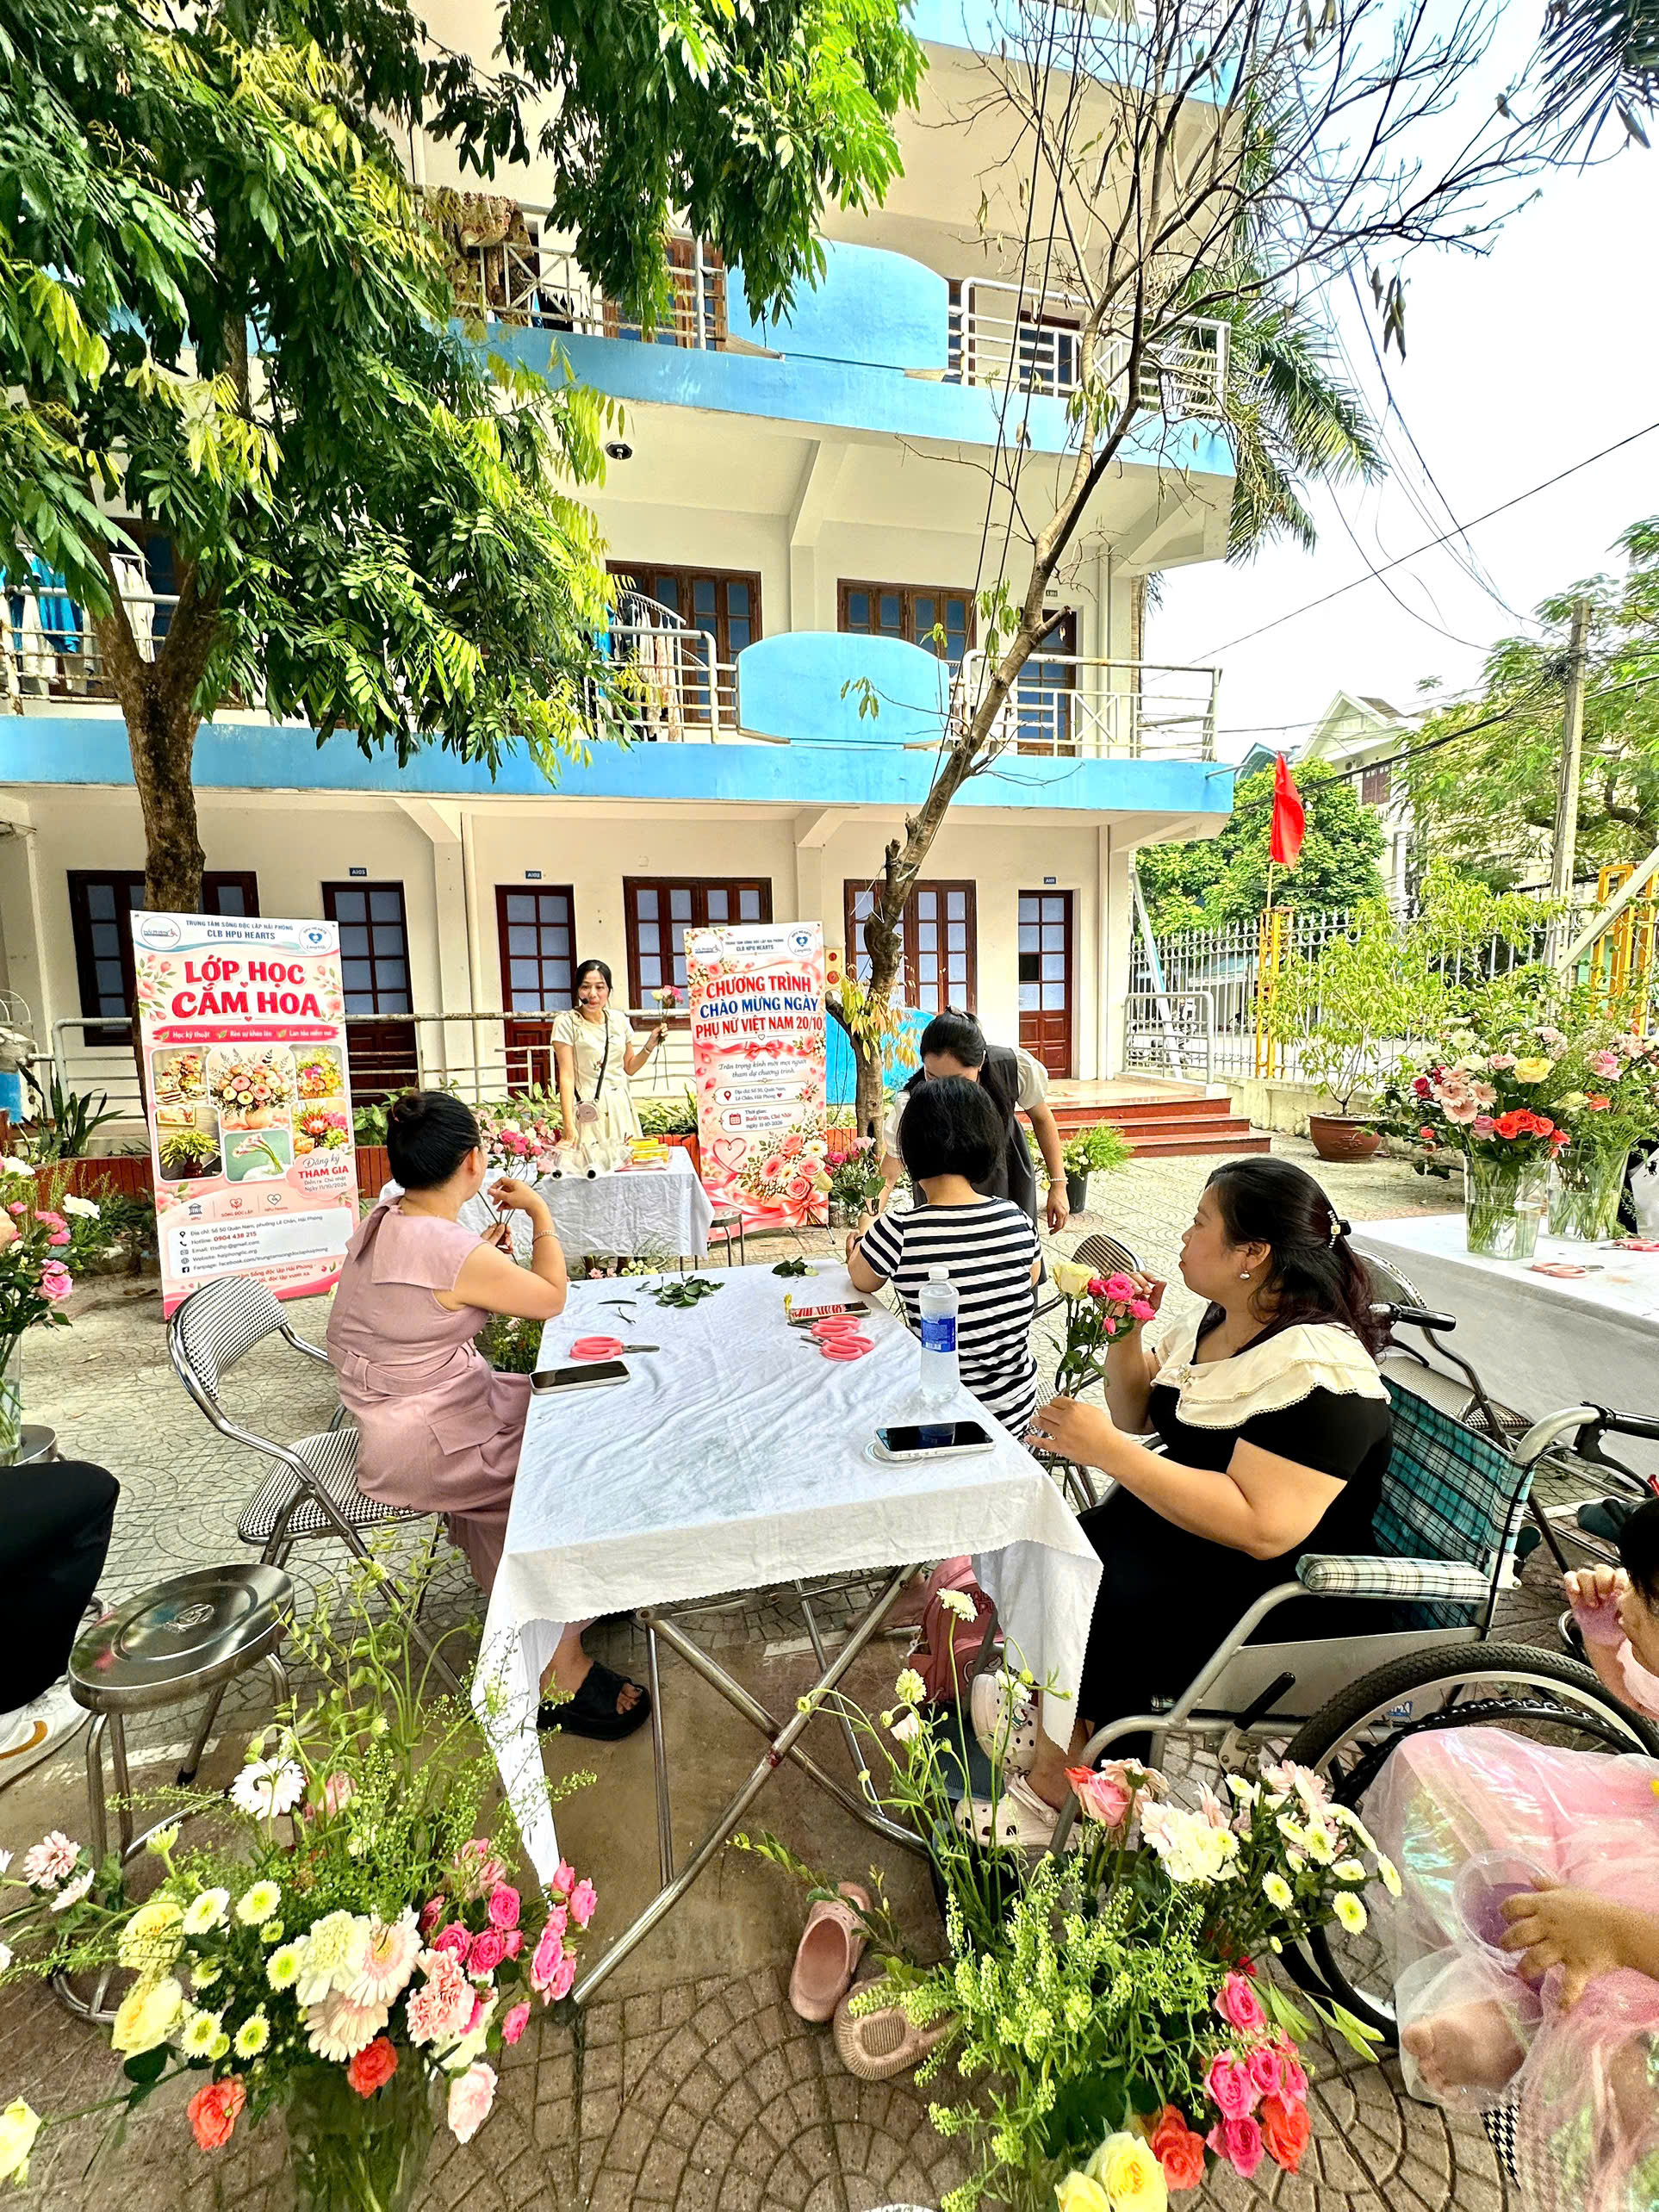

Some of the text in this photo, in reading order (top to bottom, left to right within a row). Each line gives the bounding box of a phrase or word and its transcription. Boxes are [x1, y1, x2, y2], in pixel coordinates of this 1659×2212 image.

[245, 931, 275, 940] HEARTS
[184, 954, 305, 988] LỚP HỌC
[706, 972, 811, 999] CHƯƠNG TRÌNH
[172, 983, 321, 1018] CẮM HOA
[700, 995, 818, 1018] CHÀO MỪNG NGÀY
[696, 1015, 822, 1039] PHỤ NỮ VIỆT NAM 20/10
[298, 1165, 349, 1178] THAM GIA
[303, 1153, 339, 1168] Đăng ký
